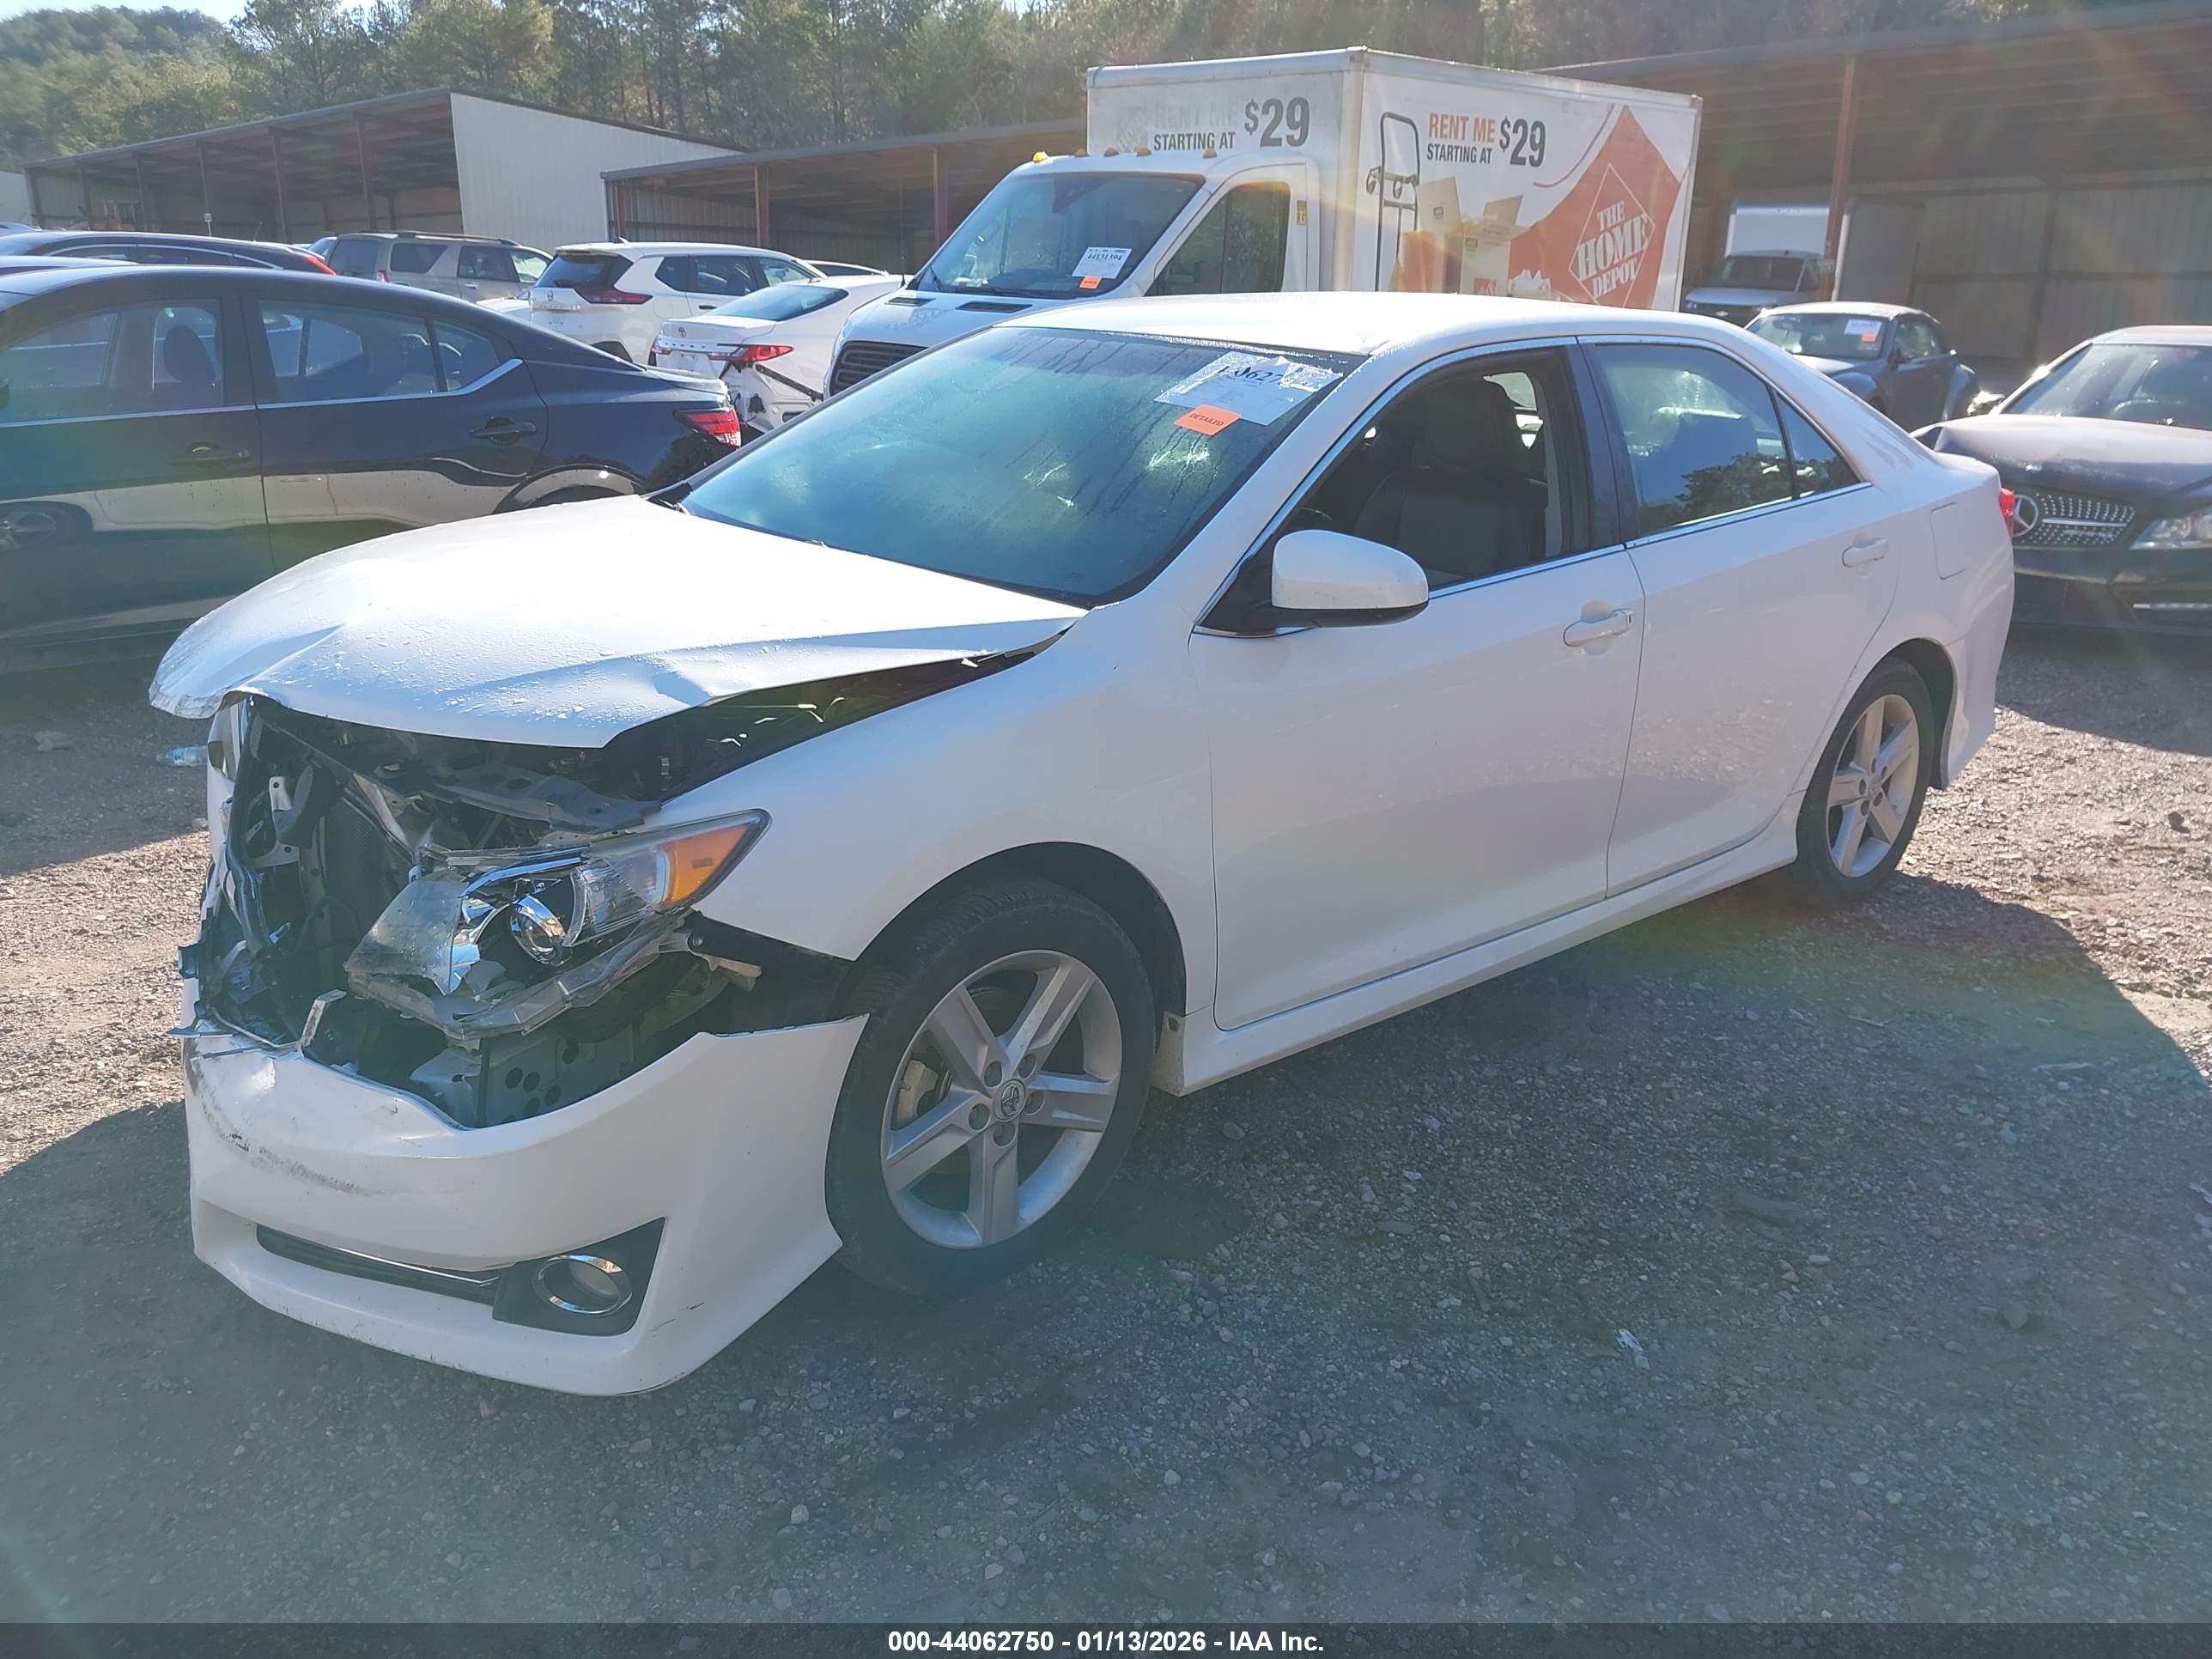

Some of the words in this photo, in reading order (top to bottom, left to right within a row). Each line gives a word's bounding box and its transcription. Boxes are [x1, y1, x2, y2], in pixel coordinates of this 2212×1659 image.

[1244, 97, 1310, 148] $29
[1429, 112, 1469, 141] RENT
[1473, 116, 1496, 143] ME
[1153, 131, 1216, 151] STARTING
[1219, 131, 1237, 149] AT
[1426, 143, 1478, 163] STARTING
[1480, 147, 1493, 164] AT
[1499, 116, 1546, 167] $29
[1597, 199, 1626, 233] THE
[1577, 213, 1650, 283] HOME
[1592, 257, 1638, 300] DEPOT
[1188, 413, 1224, 427] DETAILED
